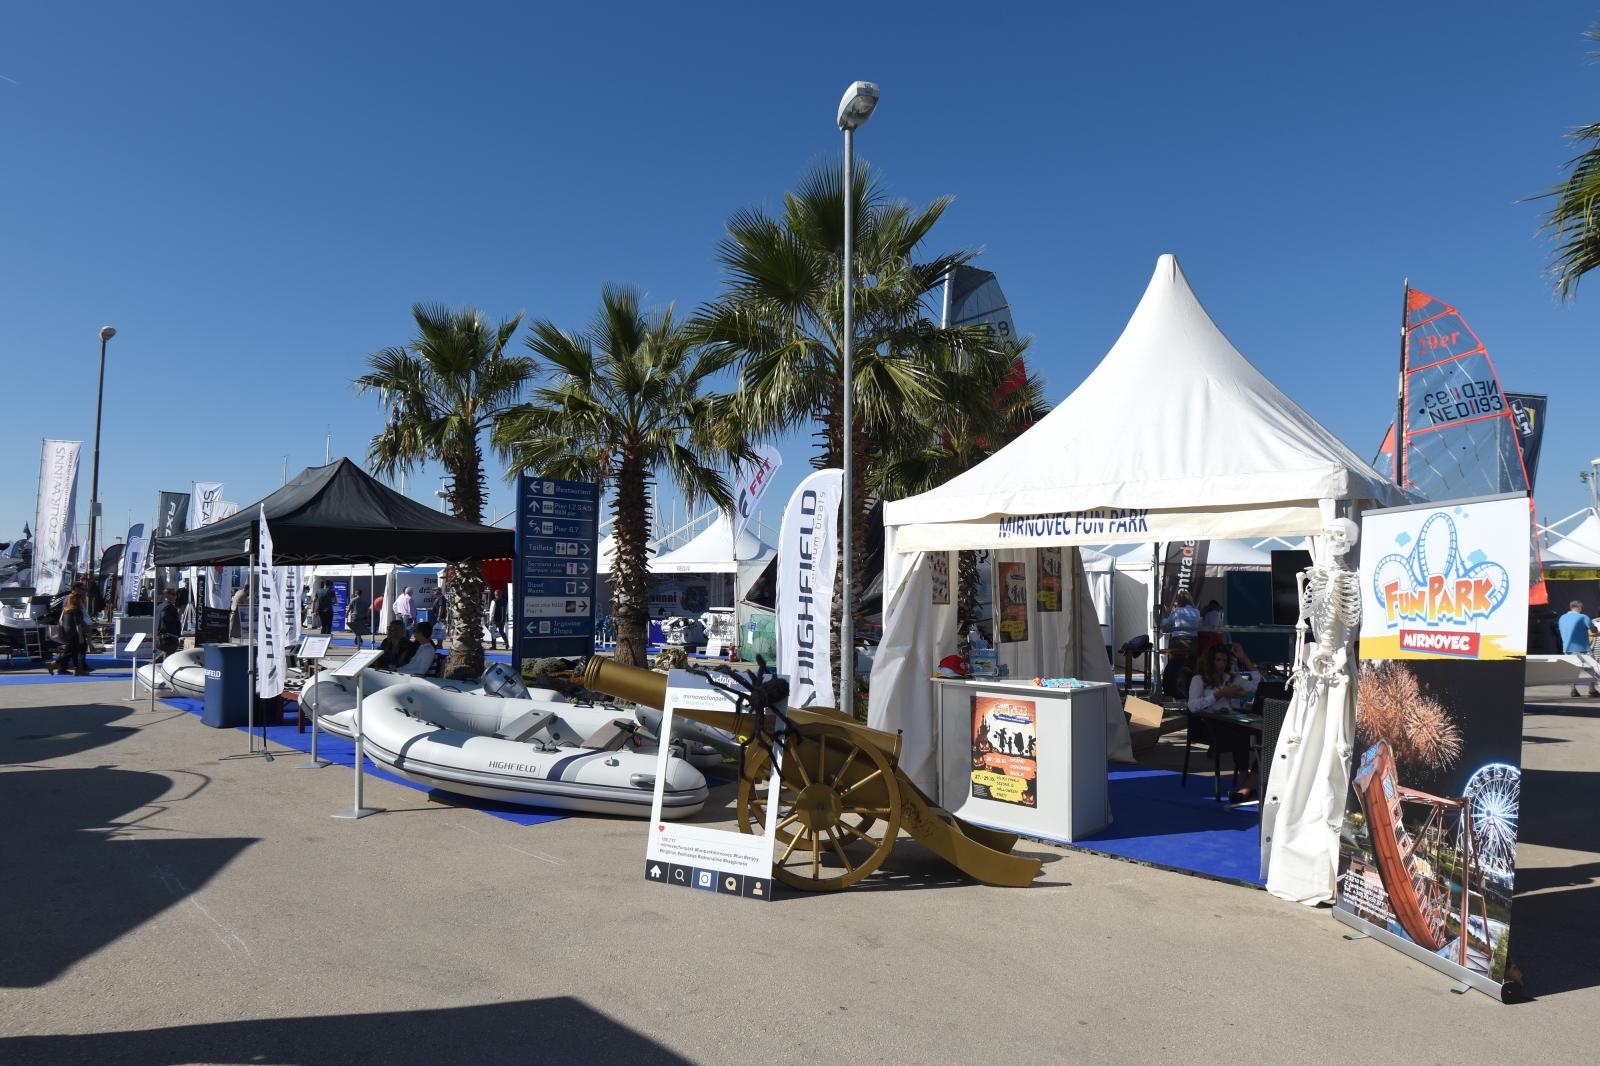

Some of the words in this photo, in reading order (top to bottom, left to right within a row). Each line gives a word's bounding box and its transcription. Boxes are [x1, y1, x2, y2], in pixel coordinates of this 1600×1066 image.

[749, 456, 770, 497] FPT
[554, 502, 568, 510] Pier
[999, 511, 1071, 538] MIRNOVEC
[1075, 510, 1105, 535] FUN
[1108, 508, 1149, 534] PARK
[797, 489, 817, 686] HIGHFIELD
[1403, 632, 1471, 651] MIRNOVEC
[488, 760, 536, 773] HIGHFIELD
